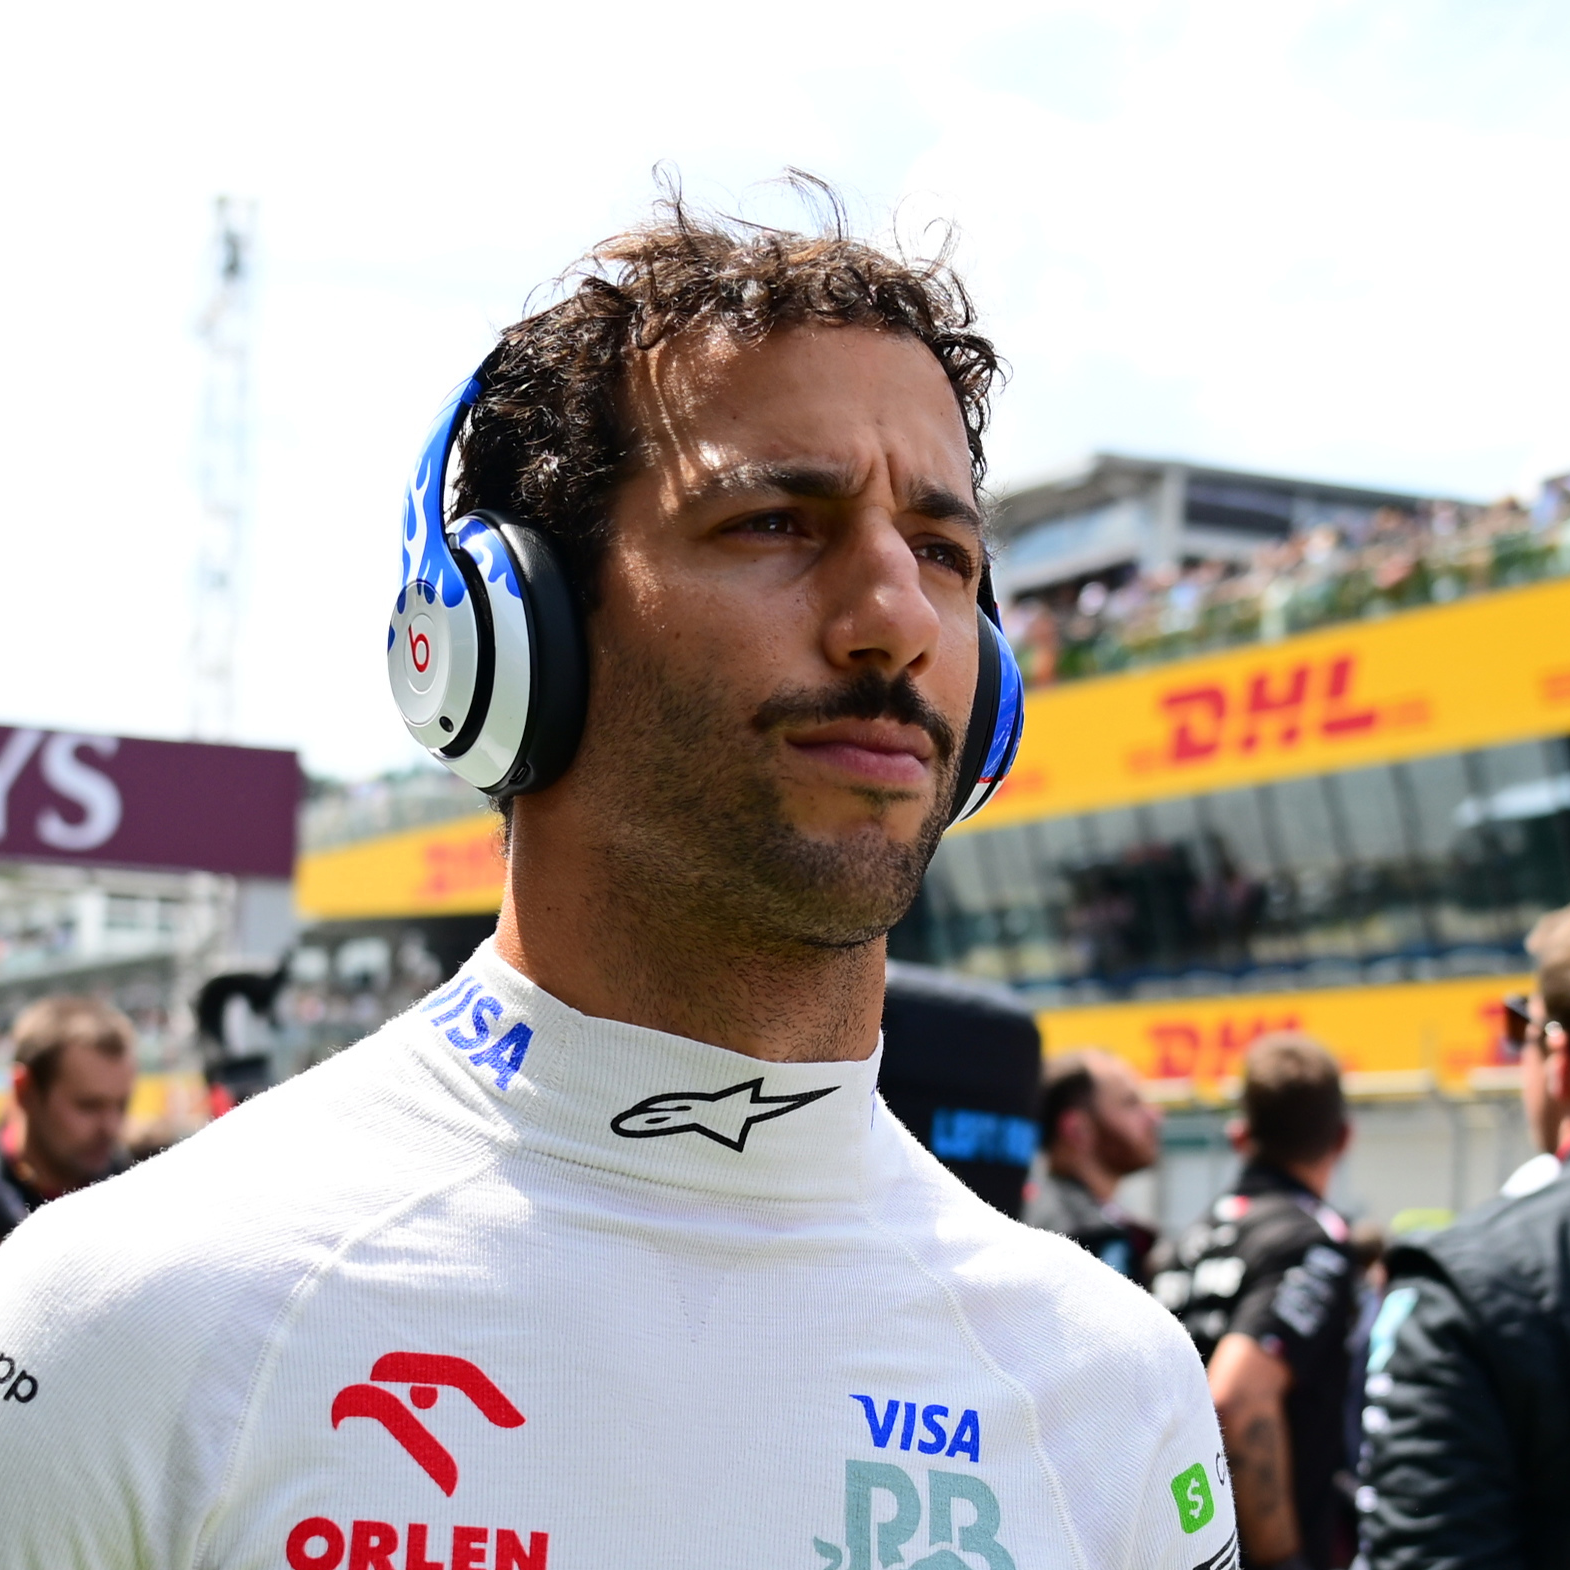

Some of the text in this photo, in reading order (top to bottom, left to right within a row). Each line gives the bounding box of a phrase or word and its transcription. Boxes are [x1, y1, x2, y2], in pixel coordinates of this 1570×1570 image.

[1156, 653, 1380, 765] DHL
[1148, 1012, 1300, 1080] DH
[849, 1394, 982, 1464] VISA
